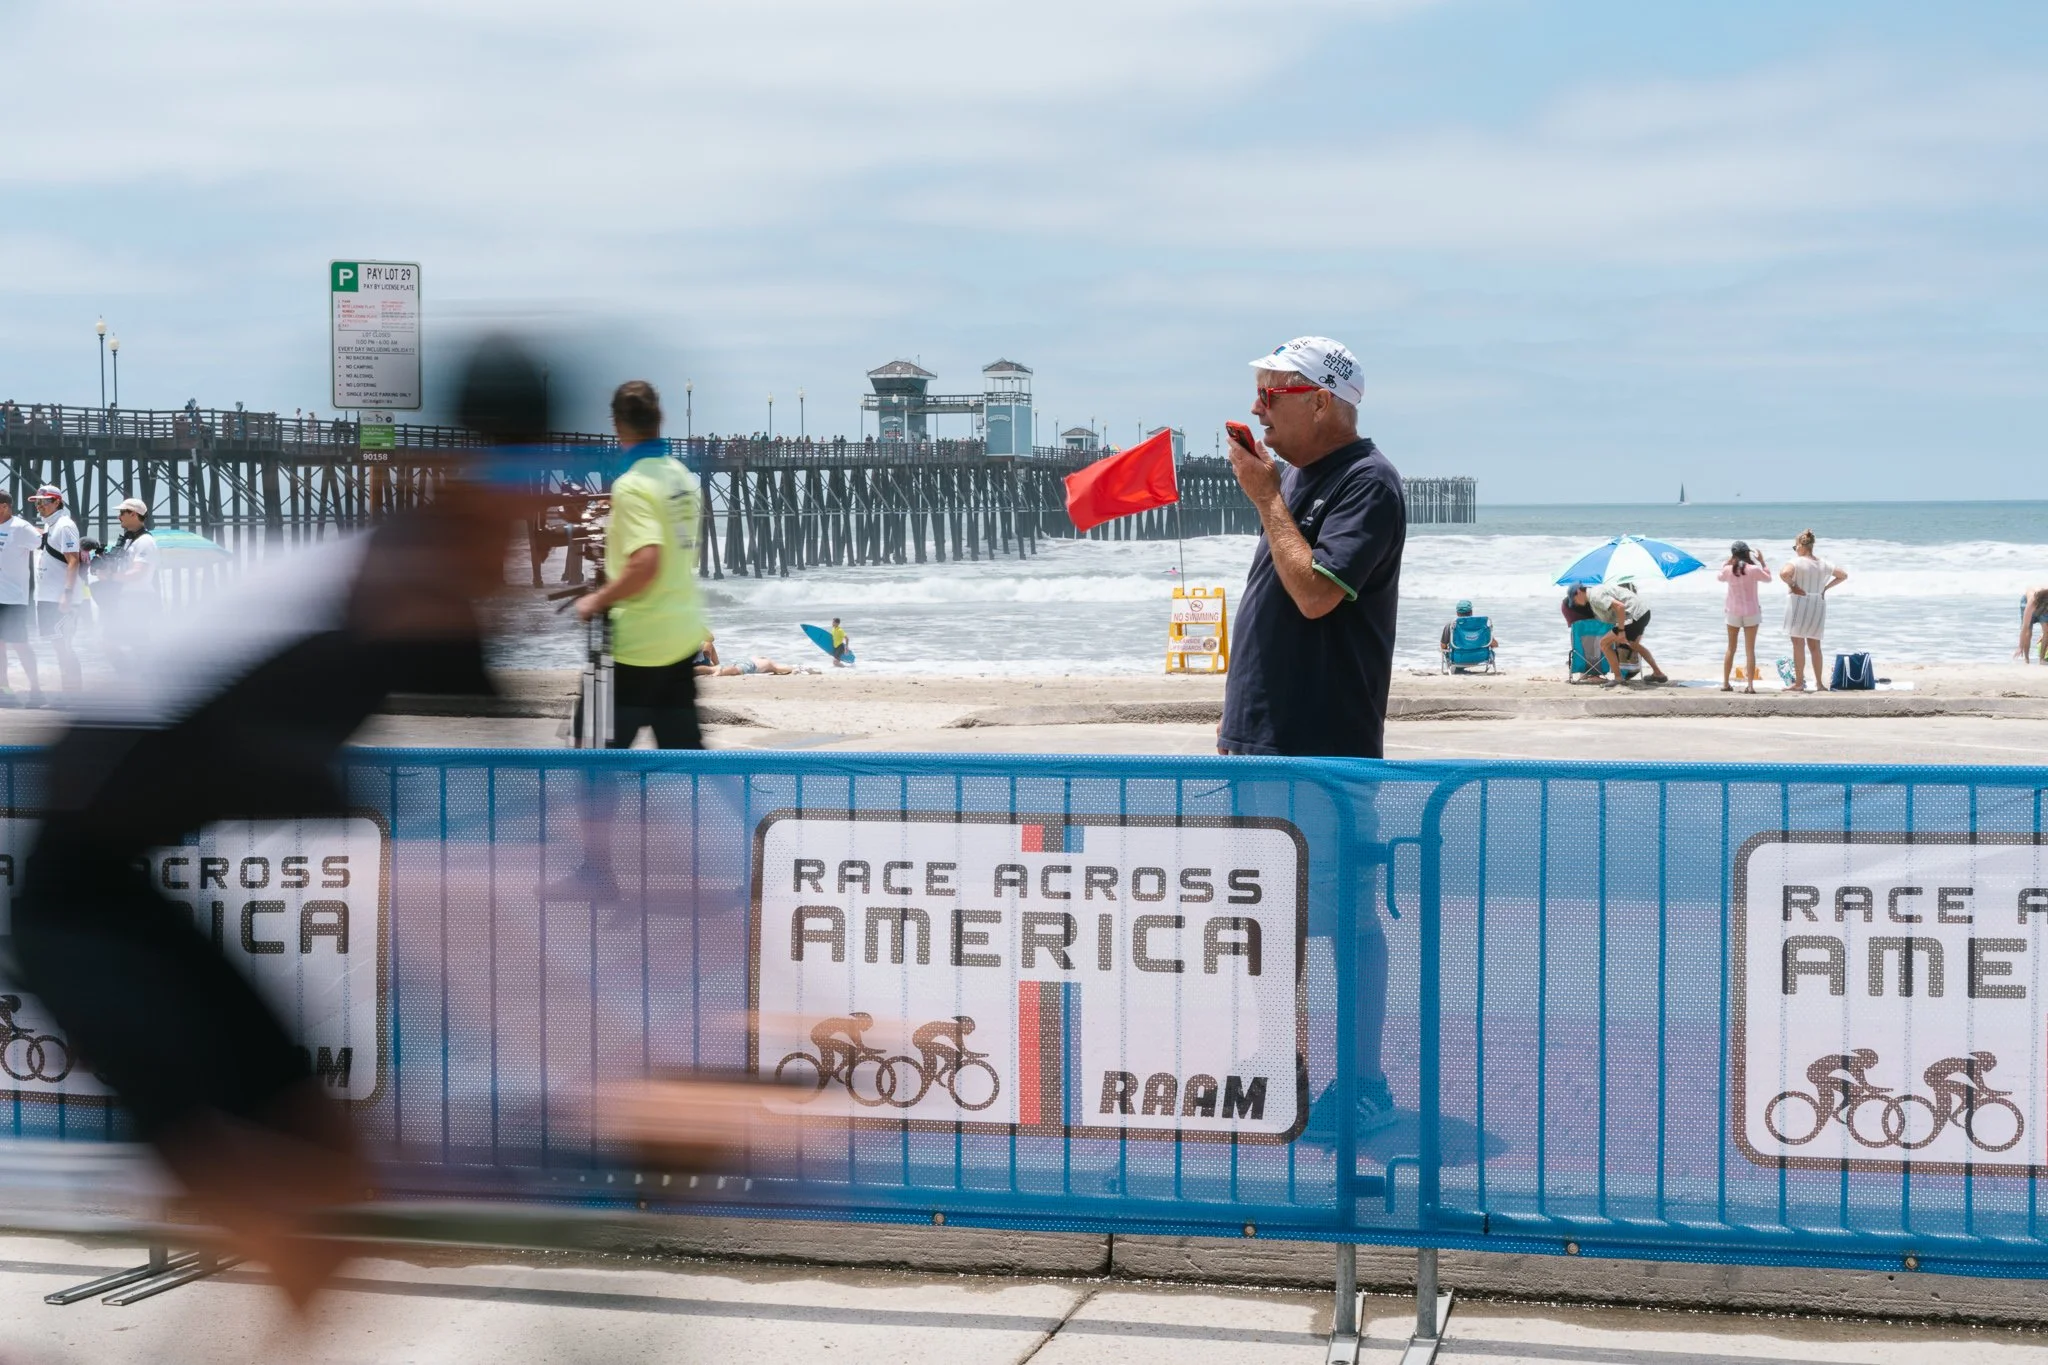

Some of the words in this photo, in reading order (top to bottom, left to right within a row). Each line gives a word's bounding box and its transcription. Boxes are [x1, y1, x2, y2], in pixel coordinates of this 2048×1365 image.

[339, 268, 354, 286] P
[367, 267, 382, 280] PAY
[385, 268, 399, 280] LOT
[401, 268, 411, 281] 29
[1325, 352, 1354, 377] BOTTLE
[1333, 349, 1353, 367] TEAM
[1323, 359, 1350, 381] CLAUS
[363, 453, 388, 461] 90158
[1173, 612, 1184, 622] NO
[1185, 612, 1219, 622] SWIMMING
[134, 855, 350, 890] CROSS
[792, 858, 956, 897] RACE
[993, 862, 1263, 905] ACROSS
[1782, 885, 1974, 924] RACE
[790, 904, 1263, 977] AMERICA
[1099, 1069, 1268, 1121] RAAM
